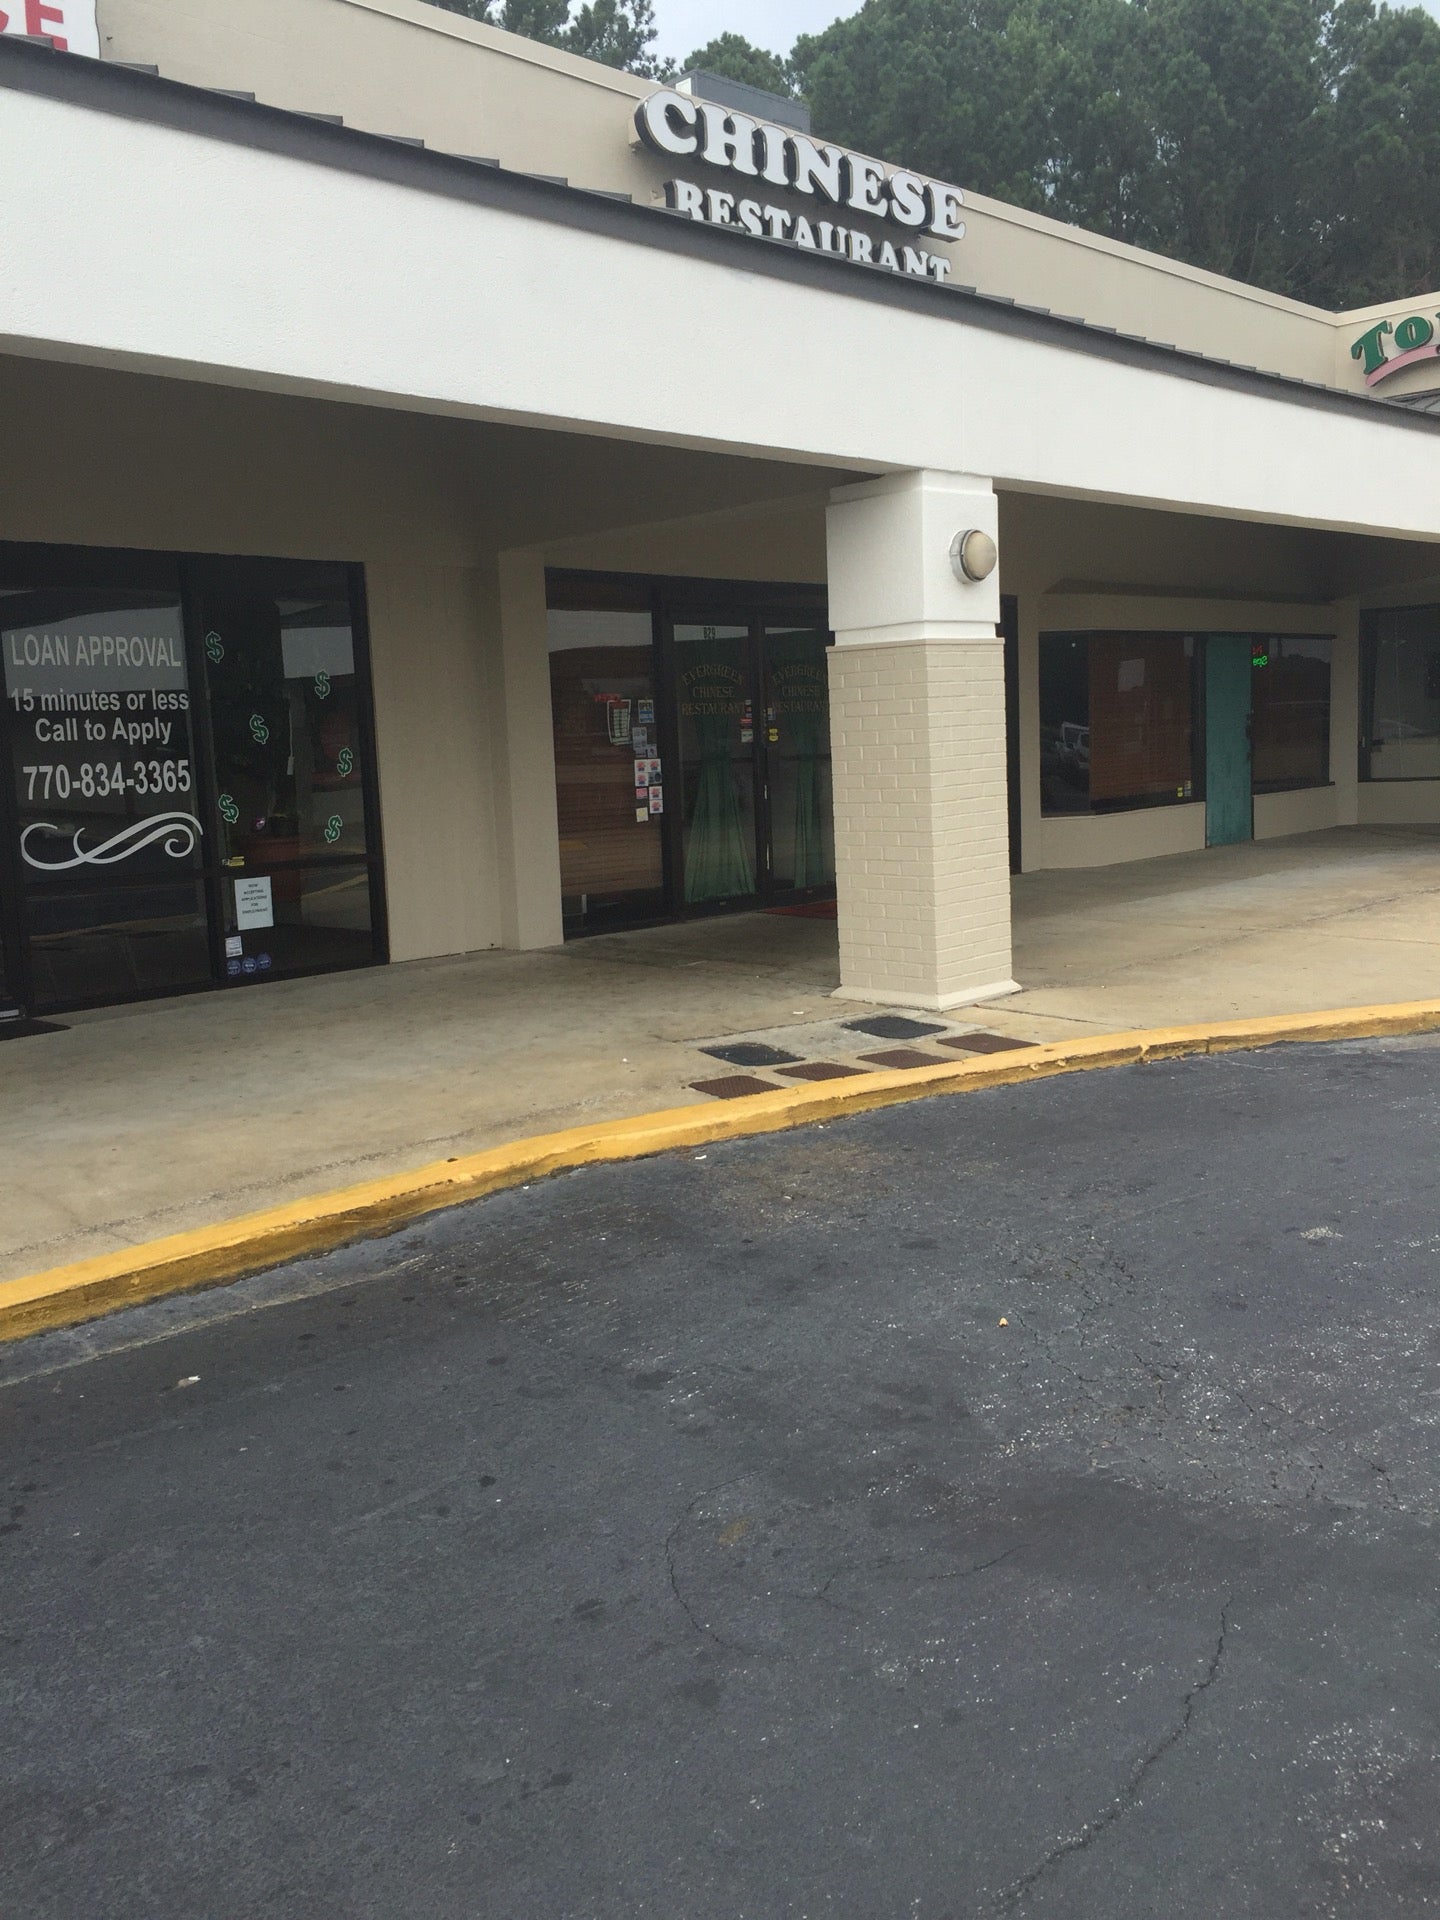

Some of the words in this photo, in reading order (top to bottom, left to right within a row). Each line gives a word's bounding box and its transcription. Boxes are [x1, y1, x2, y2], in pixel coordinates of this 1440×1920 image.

[636, 90, 966, 242] CHINESE
[668, 179, 951, 283] RESTAURANT
[11, 634, 70, 666] LOAN
[76, 635, 182, 667] APPROVAL
[11, 688, 35, 711] 15
[41, 688, 121, 711] minutes
[127, 692, 146, 710] or
[152, 688, 190, 710] less
[692, 686, 735, 698] CHINESE
[35, 717, 78, 742] Call
[84, 718, 106, 741] to
[112, 717, 172, 745] Apply
[23, 760, 191, 800] 770-834-3365
